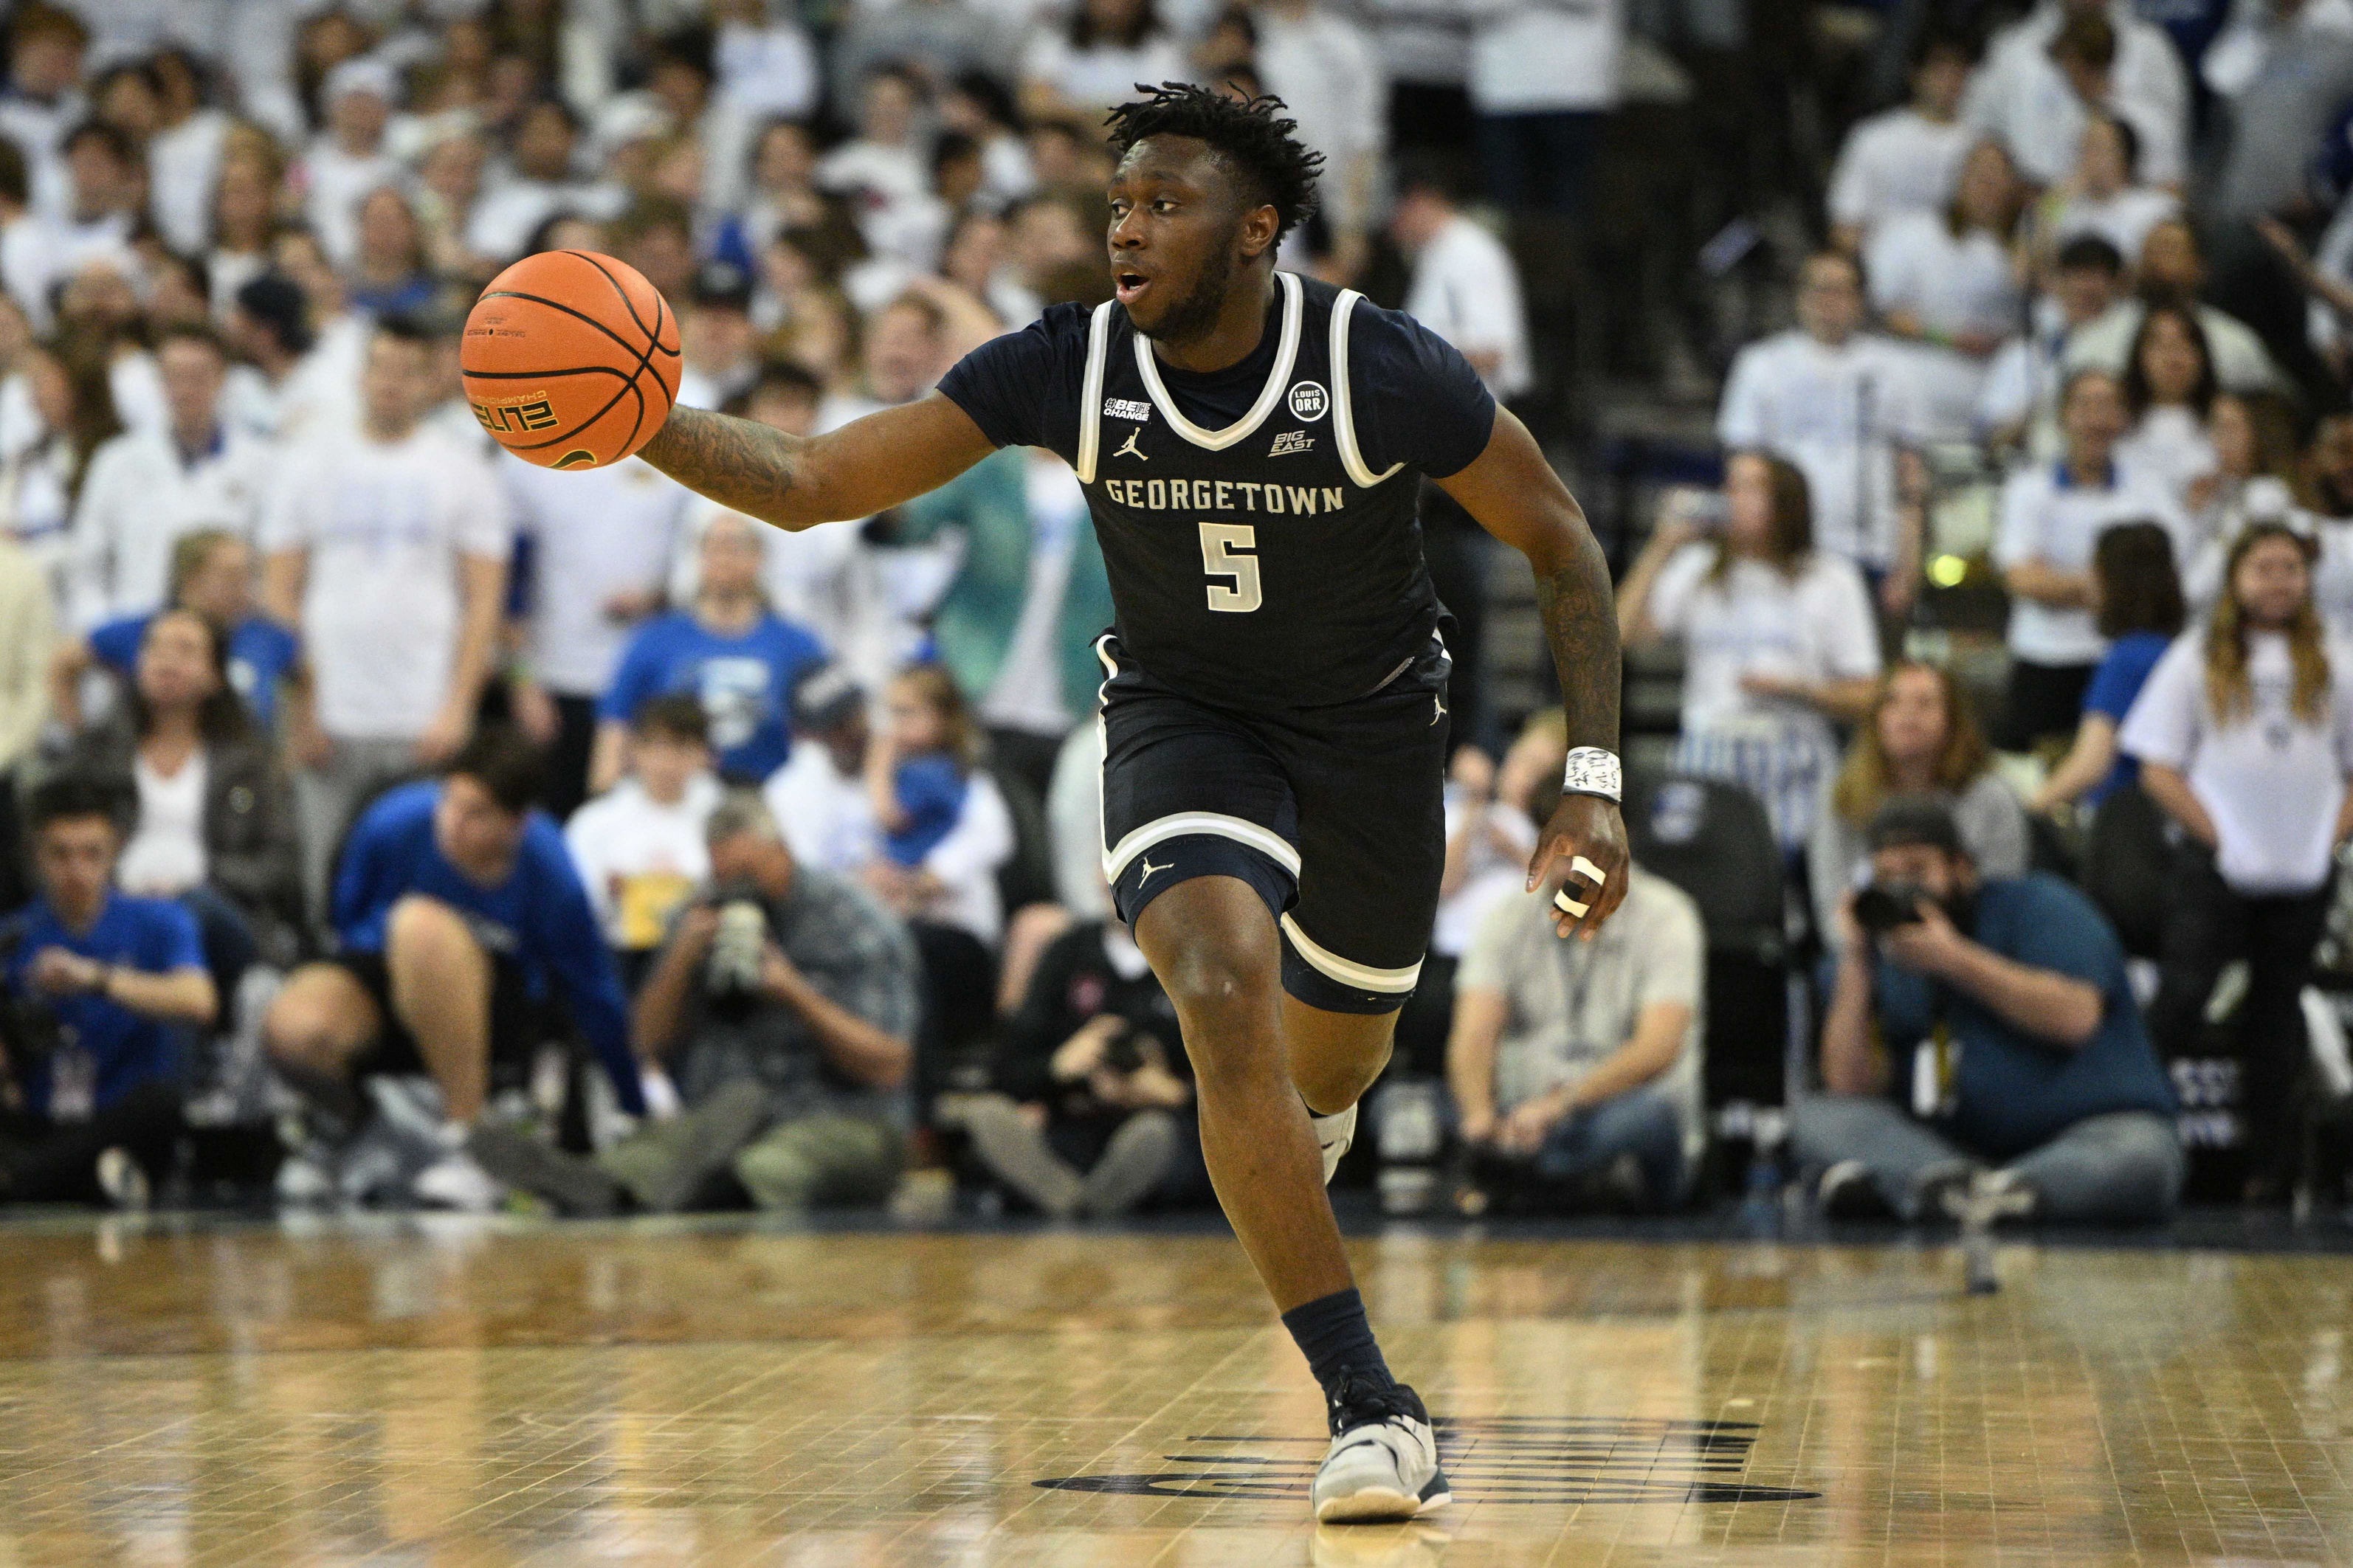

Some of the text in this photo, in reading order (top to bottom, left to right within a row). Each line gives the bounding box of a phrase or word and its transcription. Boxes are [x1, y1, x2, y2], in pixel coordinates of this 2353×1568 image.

[1295, 389, 1320, 398] LOUIS
[1295, 398, 1321, 412] ORR
[470, 399, 559, 433] ELITE
[1103, 408, 1149, 421] CHANGE
[1274, 429, 1306, 443] BIG
[1270, 438, 1316, 453] EAST
[1105, 479, 1345, 515] GEORGETOWN
[1199, 522, 1262, 612] 5
